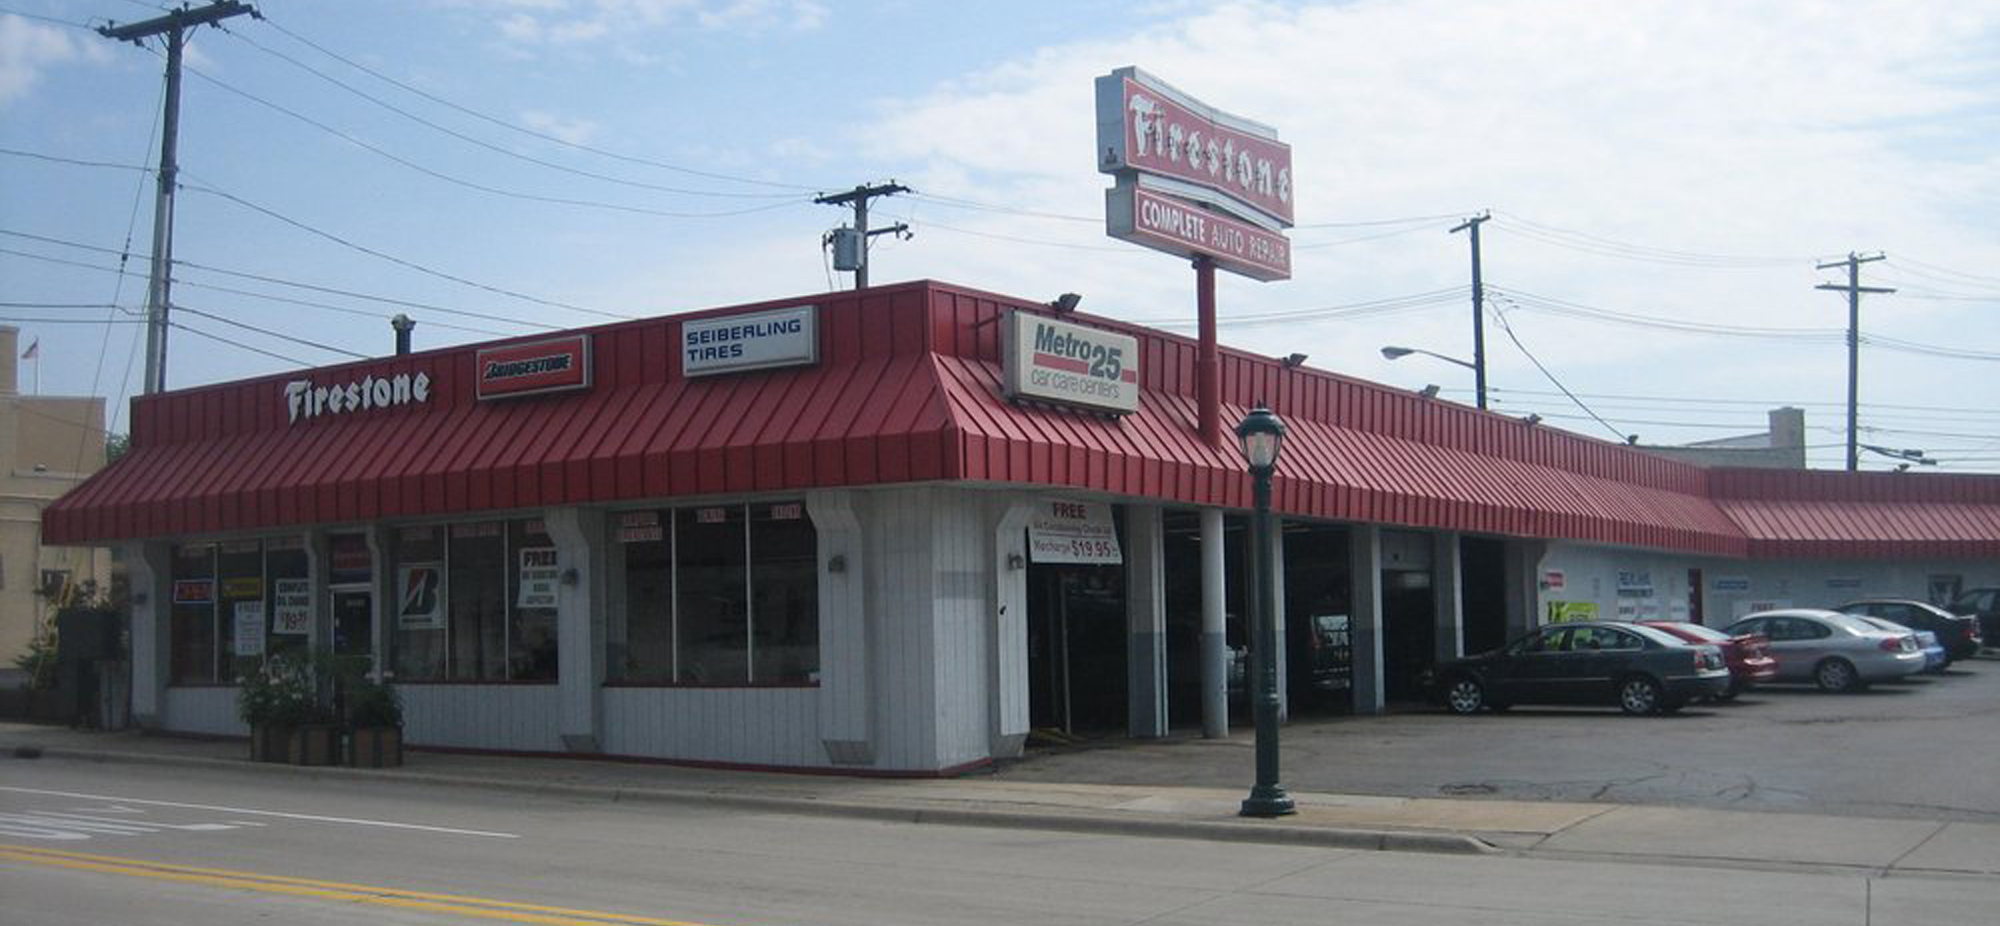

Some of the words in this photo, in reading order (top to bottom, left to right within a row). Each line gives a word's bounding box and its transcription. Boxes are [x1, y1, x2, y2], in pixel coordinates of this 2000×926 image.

[1129, 94, 1290, 202] Firestone
[1141, 200, 1205, 242] COMPLETE
[1211, 224, 1243, 252] AUTO
[1249, 236, 1286, 264] REPAIR
[687, 319, 801, 345] SEIBERLING
[688, 344, 742, 361] TIRES
[484, 354, 571, 380] BRIDGESTONE
[284, 372, 430, 425] Firestone
[1054, 503, 1087, 519] FREE
[1072, 540, 1111, 557] $19.95
